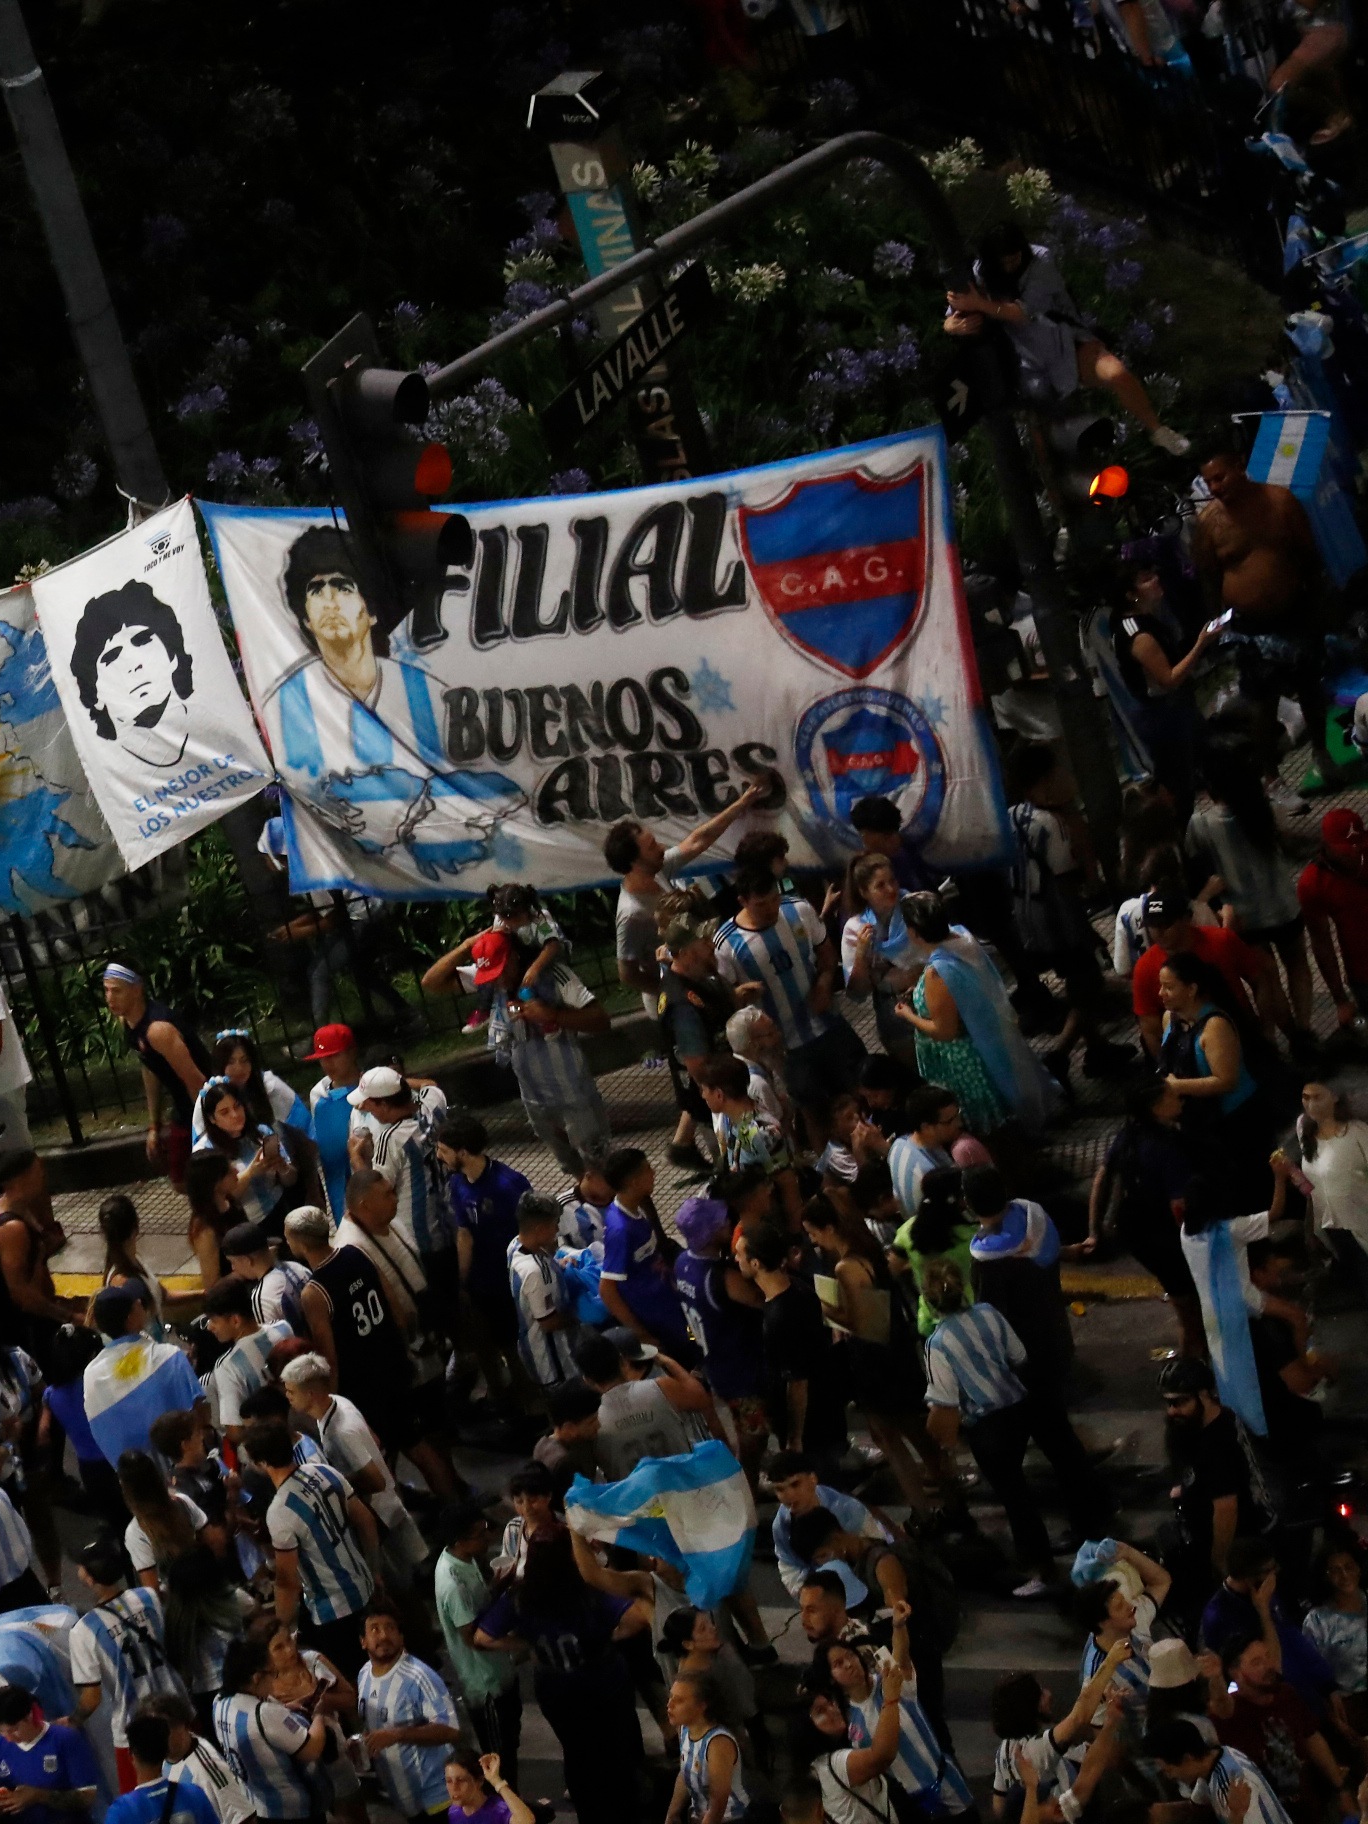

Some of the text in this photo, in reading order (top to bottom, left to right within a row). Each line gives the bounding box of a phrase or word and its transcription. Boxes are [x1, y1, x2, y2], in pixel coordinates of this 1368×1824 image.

[575, 291, 685, 425] LAVALLE
[143, 559, 158, 574] TOCO
[162, 551, 171, 561] ME
[172, 544, 185, 556] VOY
[409, 491, 750, 651] FILIAL
[780, 556, 904, 596] C.A.G.
[442, 666, 705, 763] BUENOS
[133, 753, 236, 813] EL MEJOR DE
[138, 768, 265, 839] LOS NUESTRO
[534, 741, 787, 824] AIRES
[352, 1289, 385, 1337] 30
[312, 1484, 349, 1549] 10
